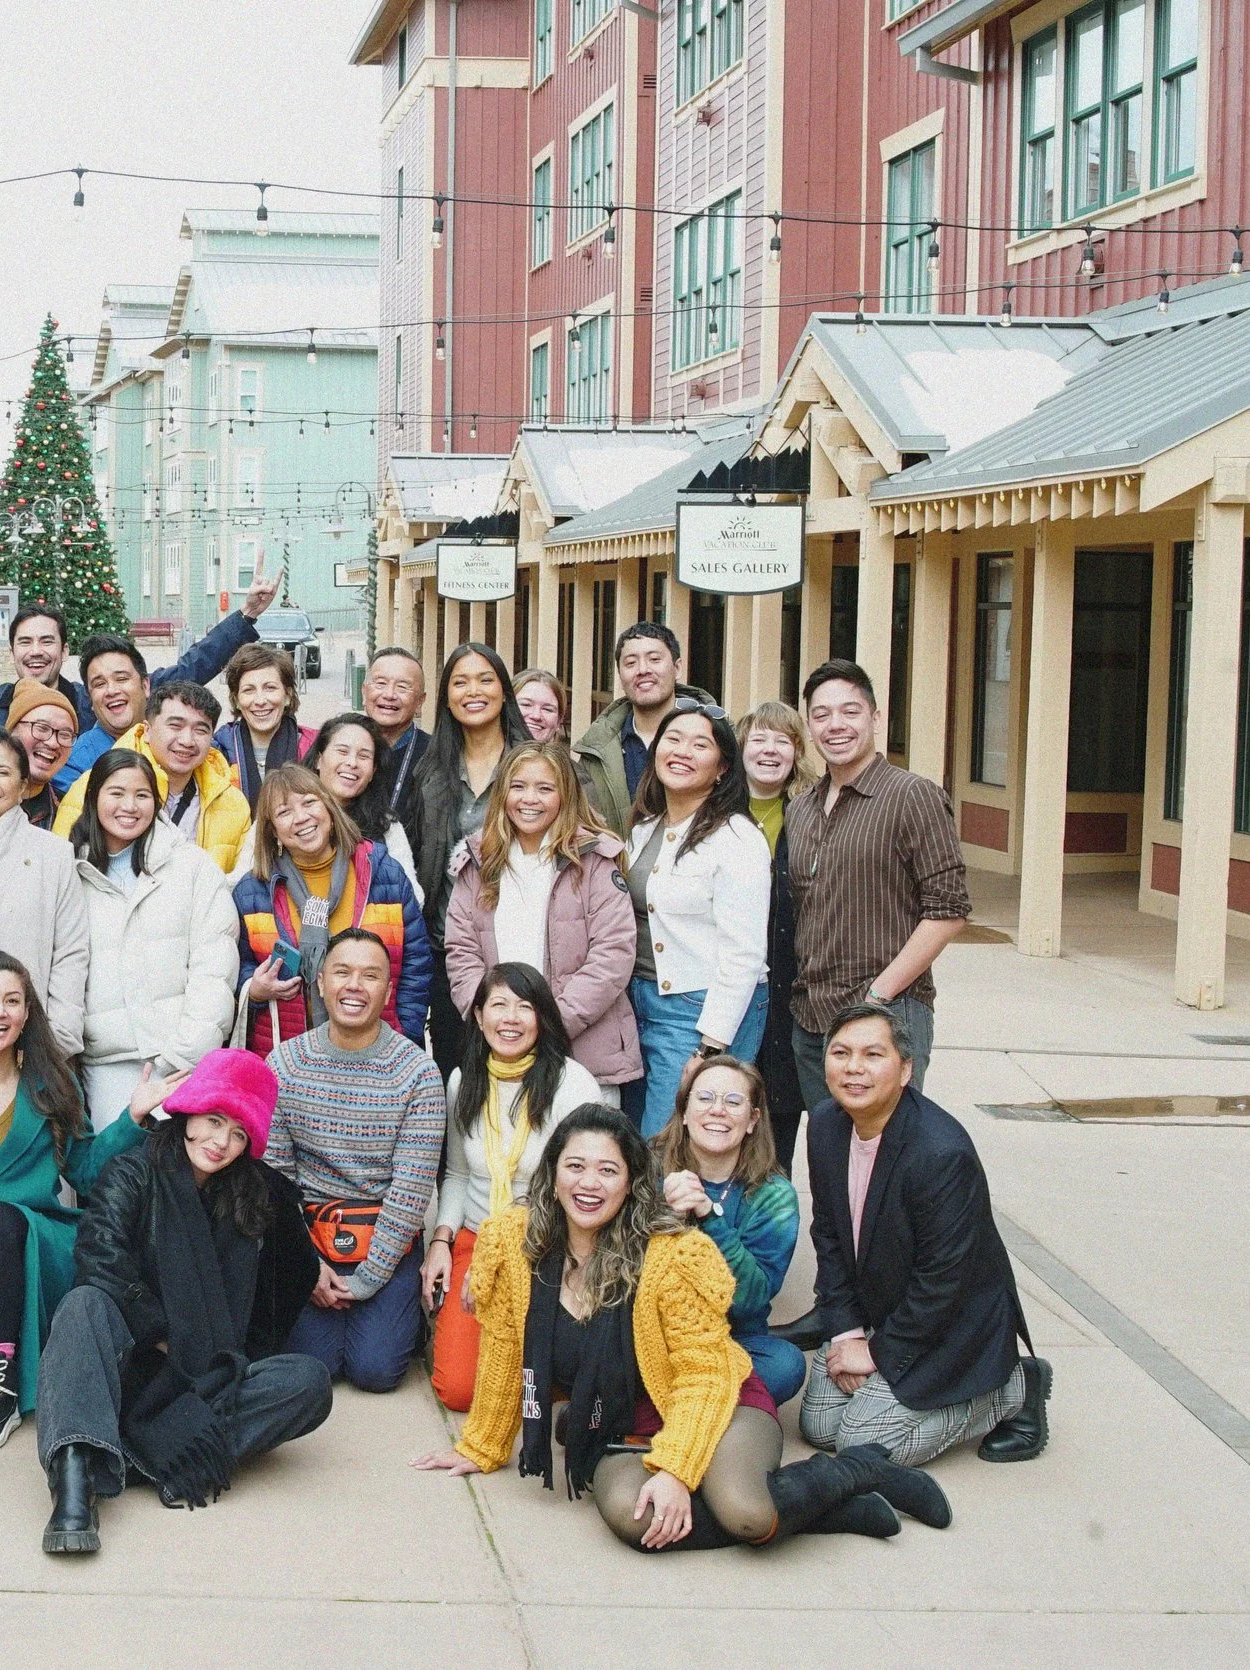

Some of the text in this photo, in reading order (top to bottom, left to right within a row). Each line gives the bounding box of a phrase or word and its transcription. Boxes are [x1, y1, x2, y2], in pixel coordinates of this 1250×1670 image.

[718, 530, 760, 540] Marriott
[691, 562, 790, 574] SALES GALLERY
[302, 912, 329, 928] EGINS
